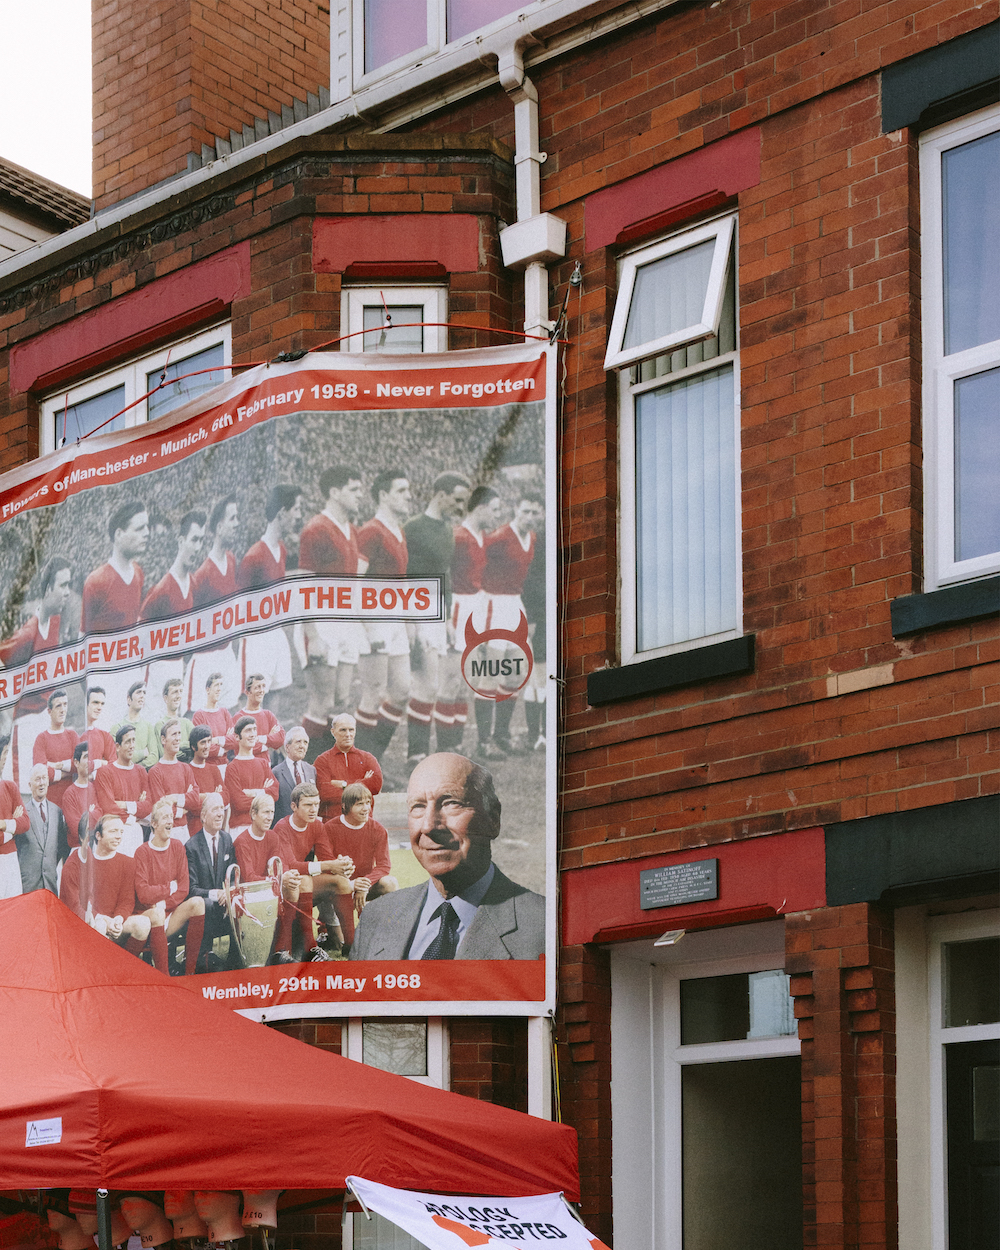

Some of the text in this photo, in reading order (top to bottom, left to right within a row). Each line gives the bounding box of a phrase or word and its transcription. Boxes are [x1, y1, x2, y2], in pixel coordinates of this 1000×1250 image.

[2, 484, 49, 518] Flowers
[53, 476, 70, 493] of
[69, 452, 150, 485] Manchester
[160, 427, 209, 458] Munich,
[211, 412, 234, 433] 6th
[236, 387, 305, 423] February
[310, 383, 358, 399] 1958
[376, 382, 433, 398] Never
[439, 377, 536, 401] Forgotten
[53, 651, 86, 679] AND
[87, 635, 145, 664] EVER,
[149, 617, 206, 651] WE'LL
[211, 590, 292, 635] FOLLOW
[299, 586, 352, 610] THE
[361, 587, 431, 611] BOYS
[470, 657, 524, 678] MUST
[654, 870, 676, 878] WILLIAM
[201, 974, 421, 1001] Wembley, 29th May 1968
[418, 1200, 520, 1223] APOLOGY
[468, 1222, 568, 1241] CCEPTED
